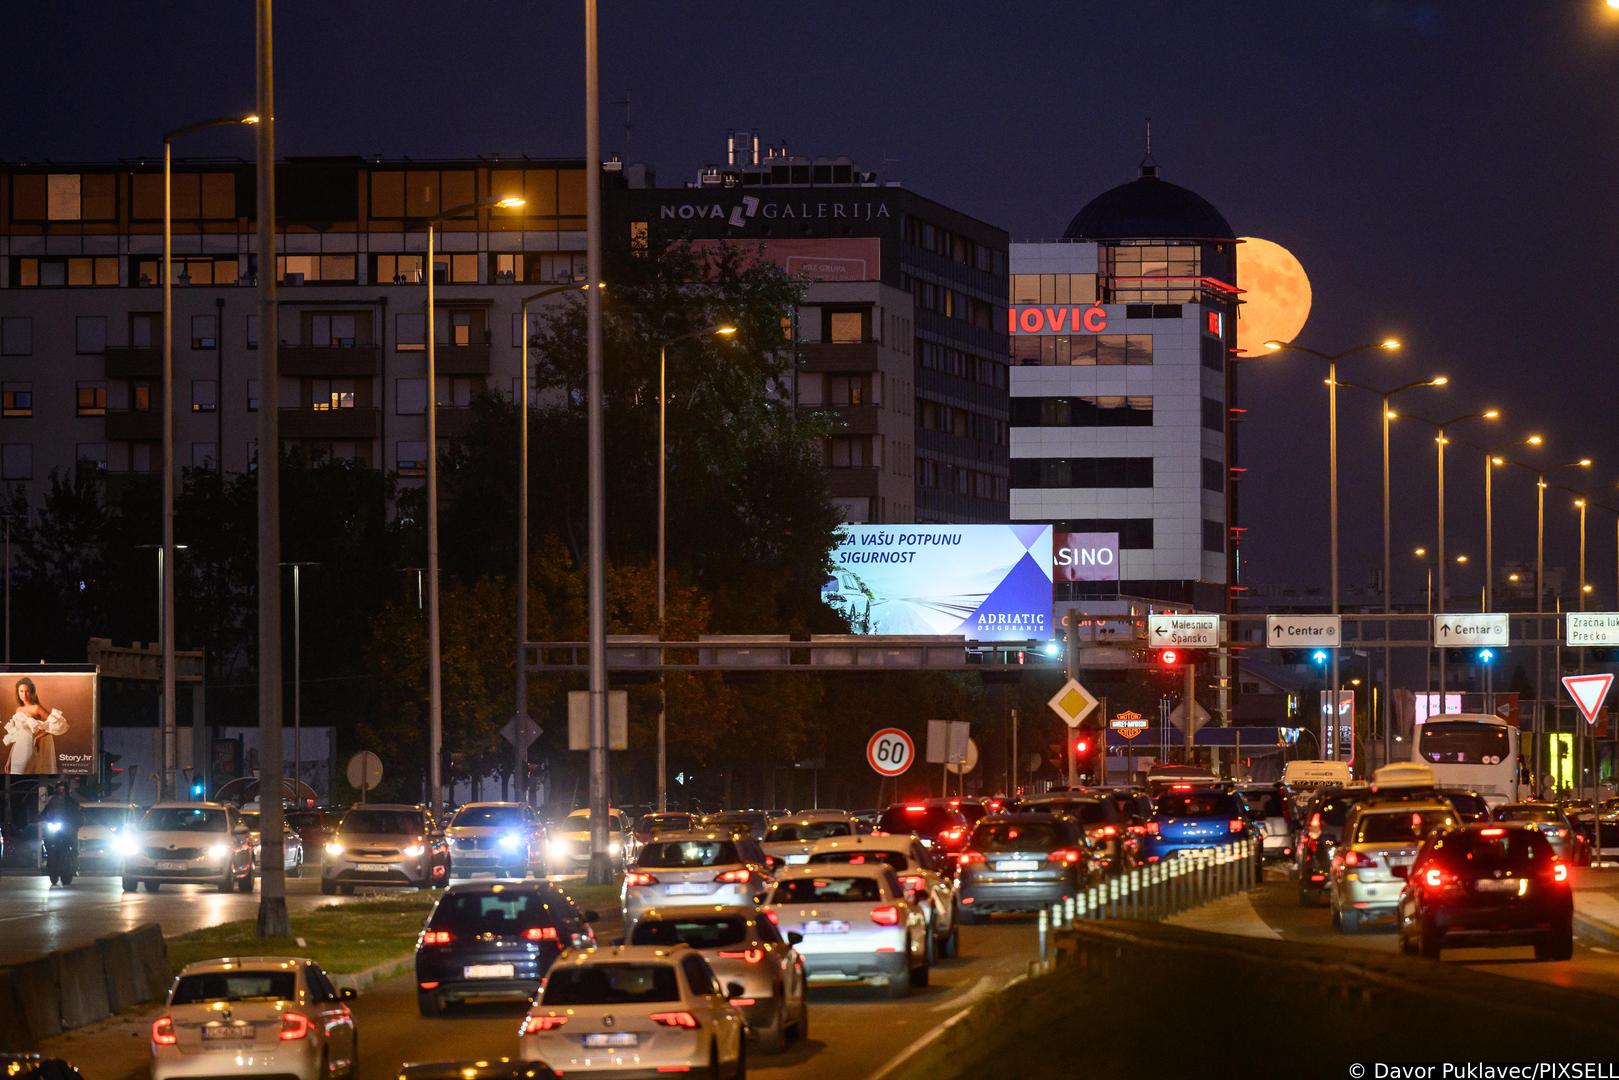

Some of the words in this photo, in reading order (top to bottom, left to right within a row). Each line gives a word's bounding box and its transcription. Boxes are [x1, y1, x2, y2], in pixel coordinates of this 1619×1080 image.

[660, 204, 725, 219] NOVA
[762, 202, 890, 220] GALERIJA
[1008, 300, 1107, 332] OVIĆ
[861, 531, 894, 546] VAŠU
[898, 534, 962, 546] POTPUNU
[839, 551, 916, 563] SIGURNOST
[977, 613, 1044, 624] ADRIATIC
[1172, 620, 1213, 629] Malesnica
[1455, 624, 1491, 635] Centar
[1287, 625, 1323, 636] Centar
[877, 739, 905, 764] 60
[59, 753, 92, 763] Story.hr
